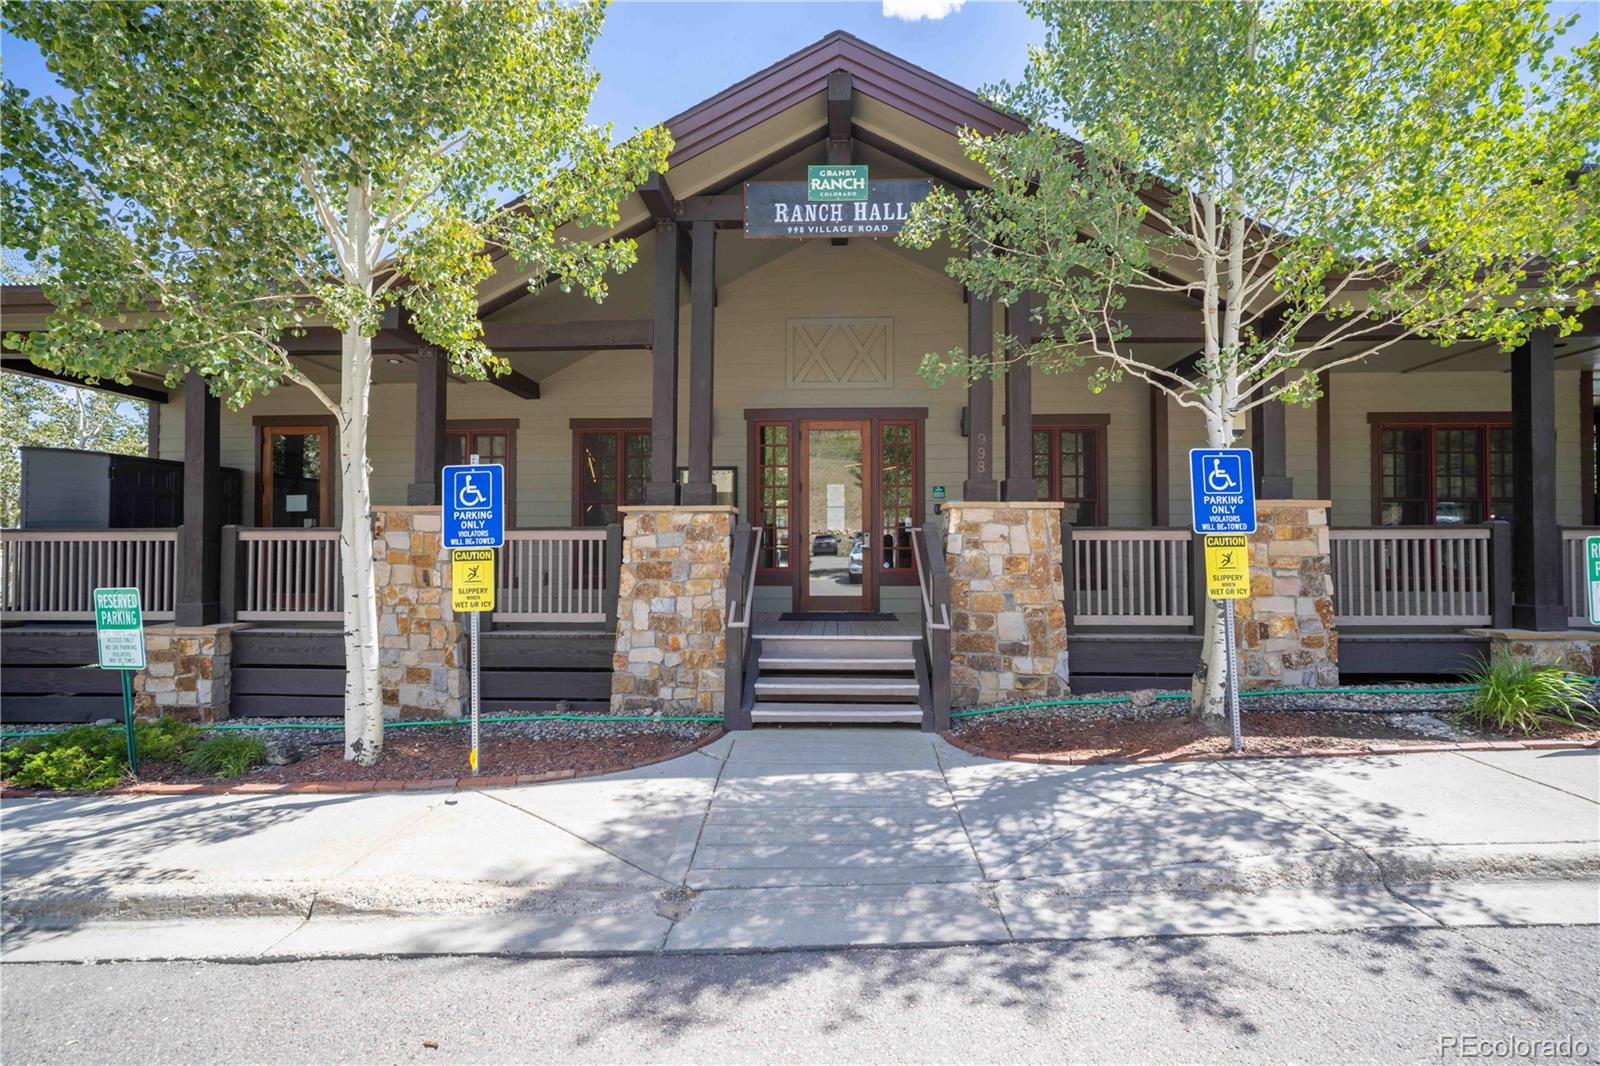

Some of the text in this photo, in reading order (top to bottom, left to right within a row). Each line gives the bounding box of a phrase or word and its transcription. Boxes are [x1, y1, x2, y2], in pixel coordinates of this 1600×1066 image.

[810, 178, 864, 190] RANCH
[774, 202, 908, 222] RANCH HALL
[808, 225, 853, 233] VILLAGE
[977, 432, 986, 473] 998
[1203, 495, 1244, 504] PARKING
[1211, 505, 1236, 514] ONLY
[453, 511, 493, 520] PARKING
[460, 520, 486, 529] ONLY
[1207, 537, 1245, 546] CAUTION
[455, 551, 491, 560] CAUTION
[1212, 574, 1243, 582] SLIPPERY
[458, 587, 489, 595] SLIPPERY
[97, 593, 138, 609] RESERVED
[101, 610, 137, 626] PARKING
